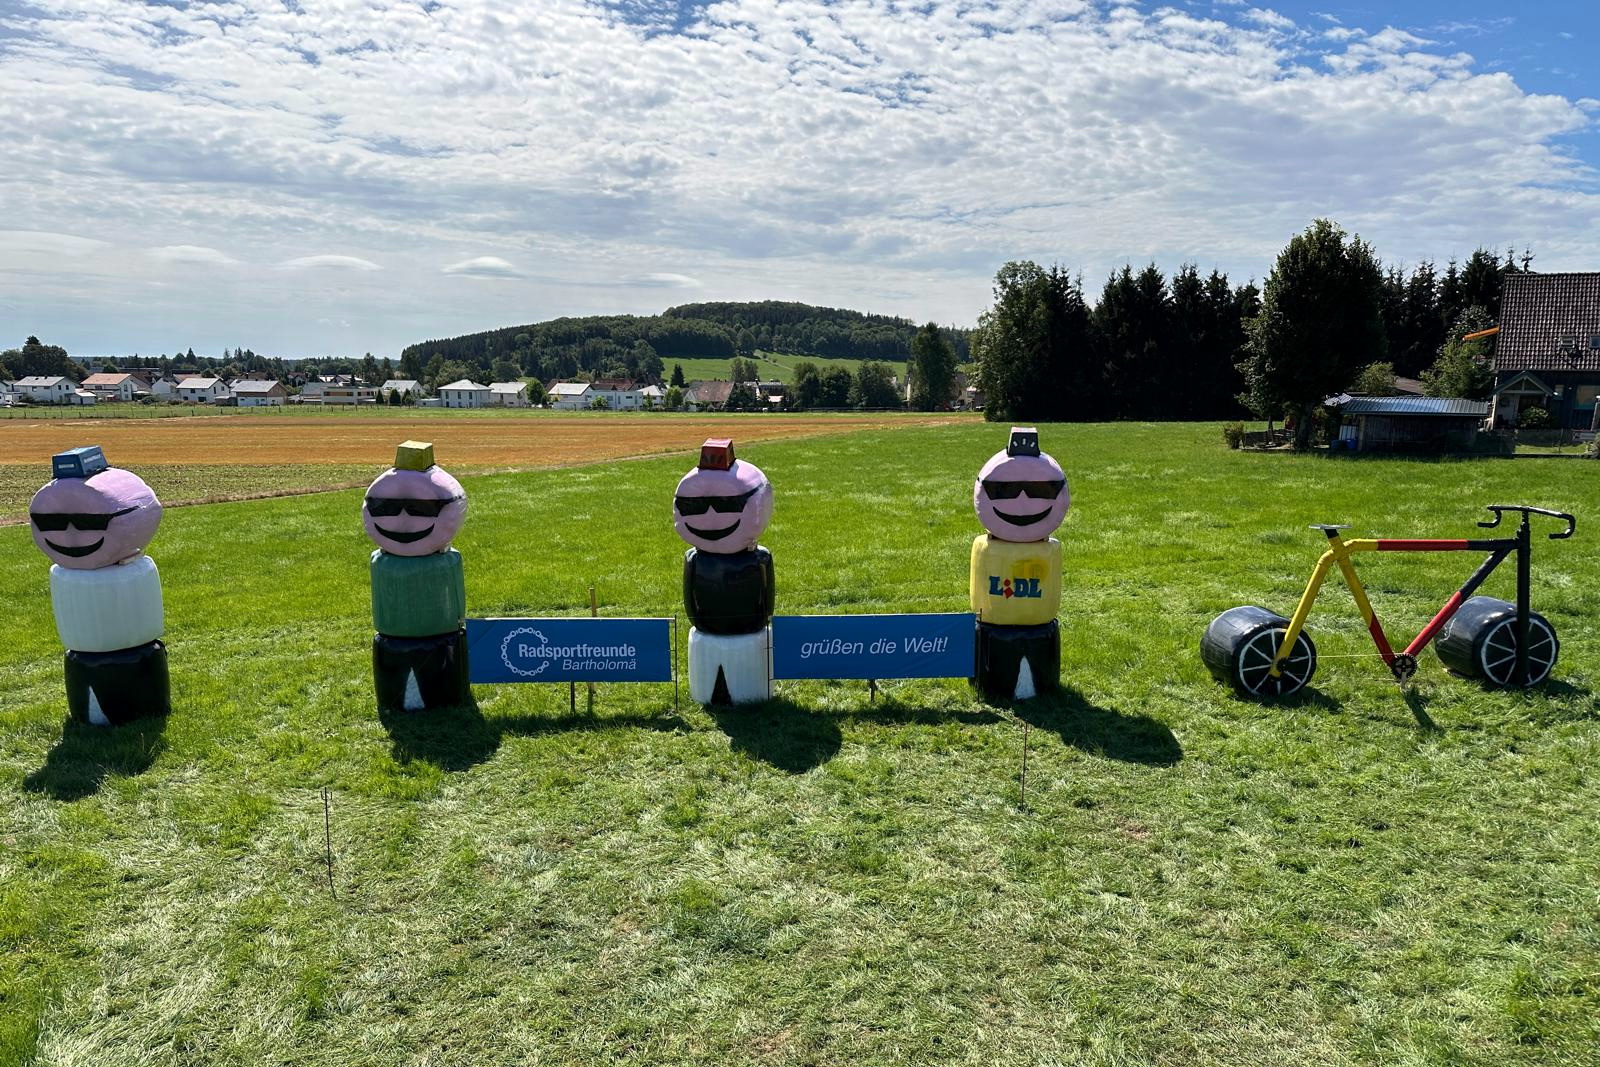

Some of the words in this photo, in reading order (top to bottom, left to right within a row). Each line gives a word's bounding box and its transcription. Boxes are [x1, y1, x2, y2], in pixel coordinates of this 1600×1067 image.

[518, 643, 636, 660] Radsportfreunde
[801, 638, 864, 658] grüßen
[870, 638, 897, 655] die
[904, 636, 948, 654] Welt!
[562, 659, 637, 671] Bartholomä
